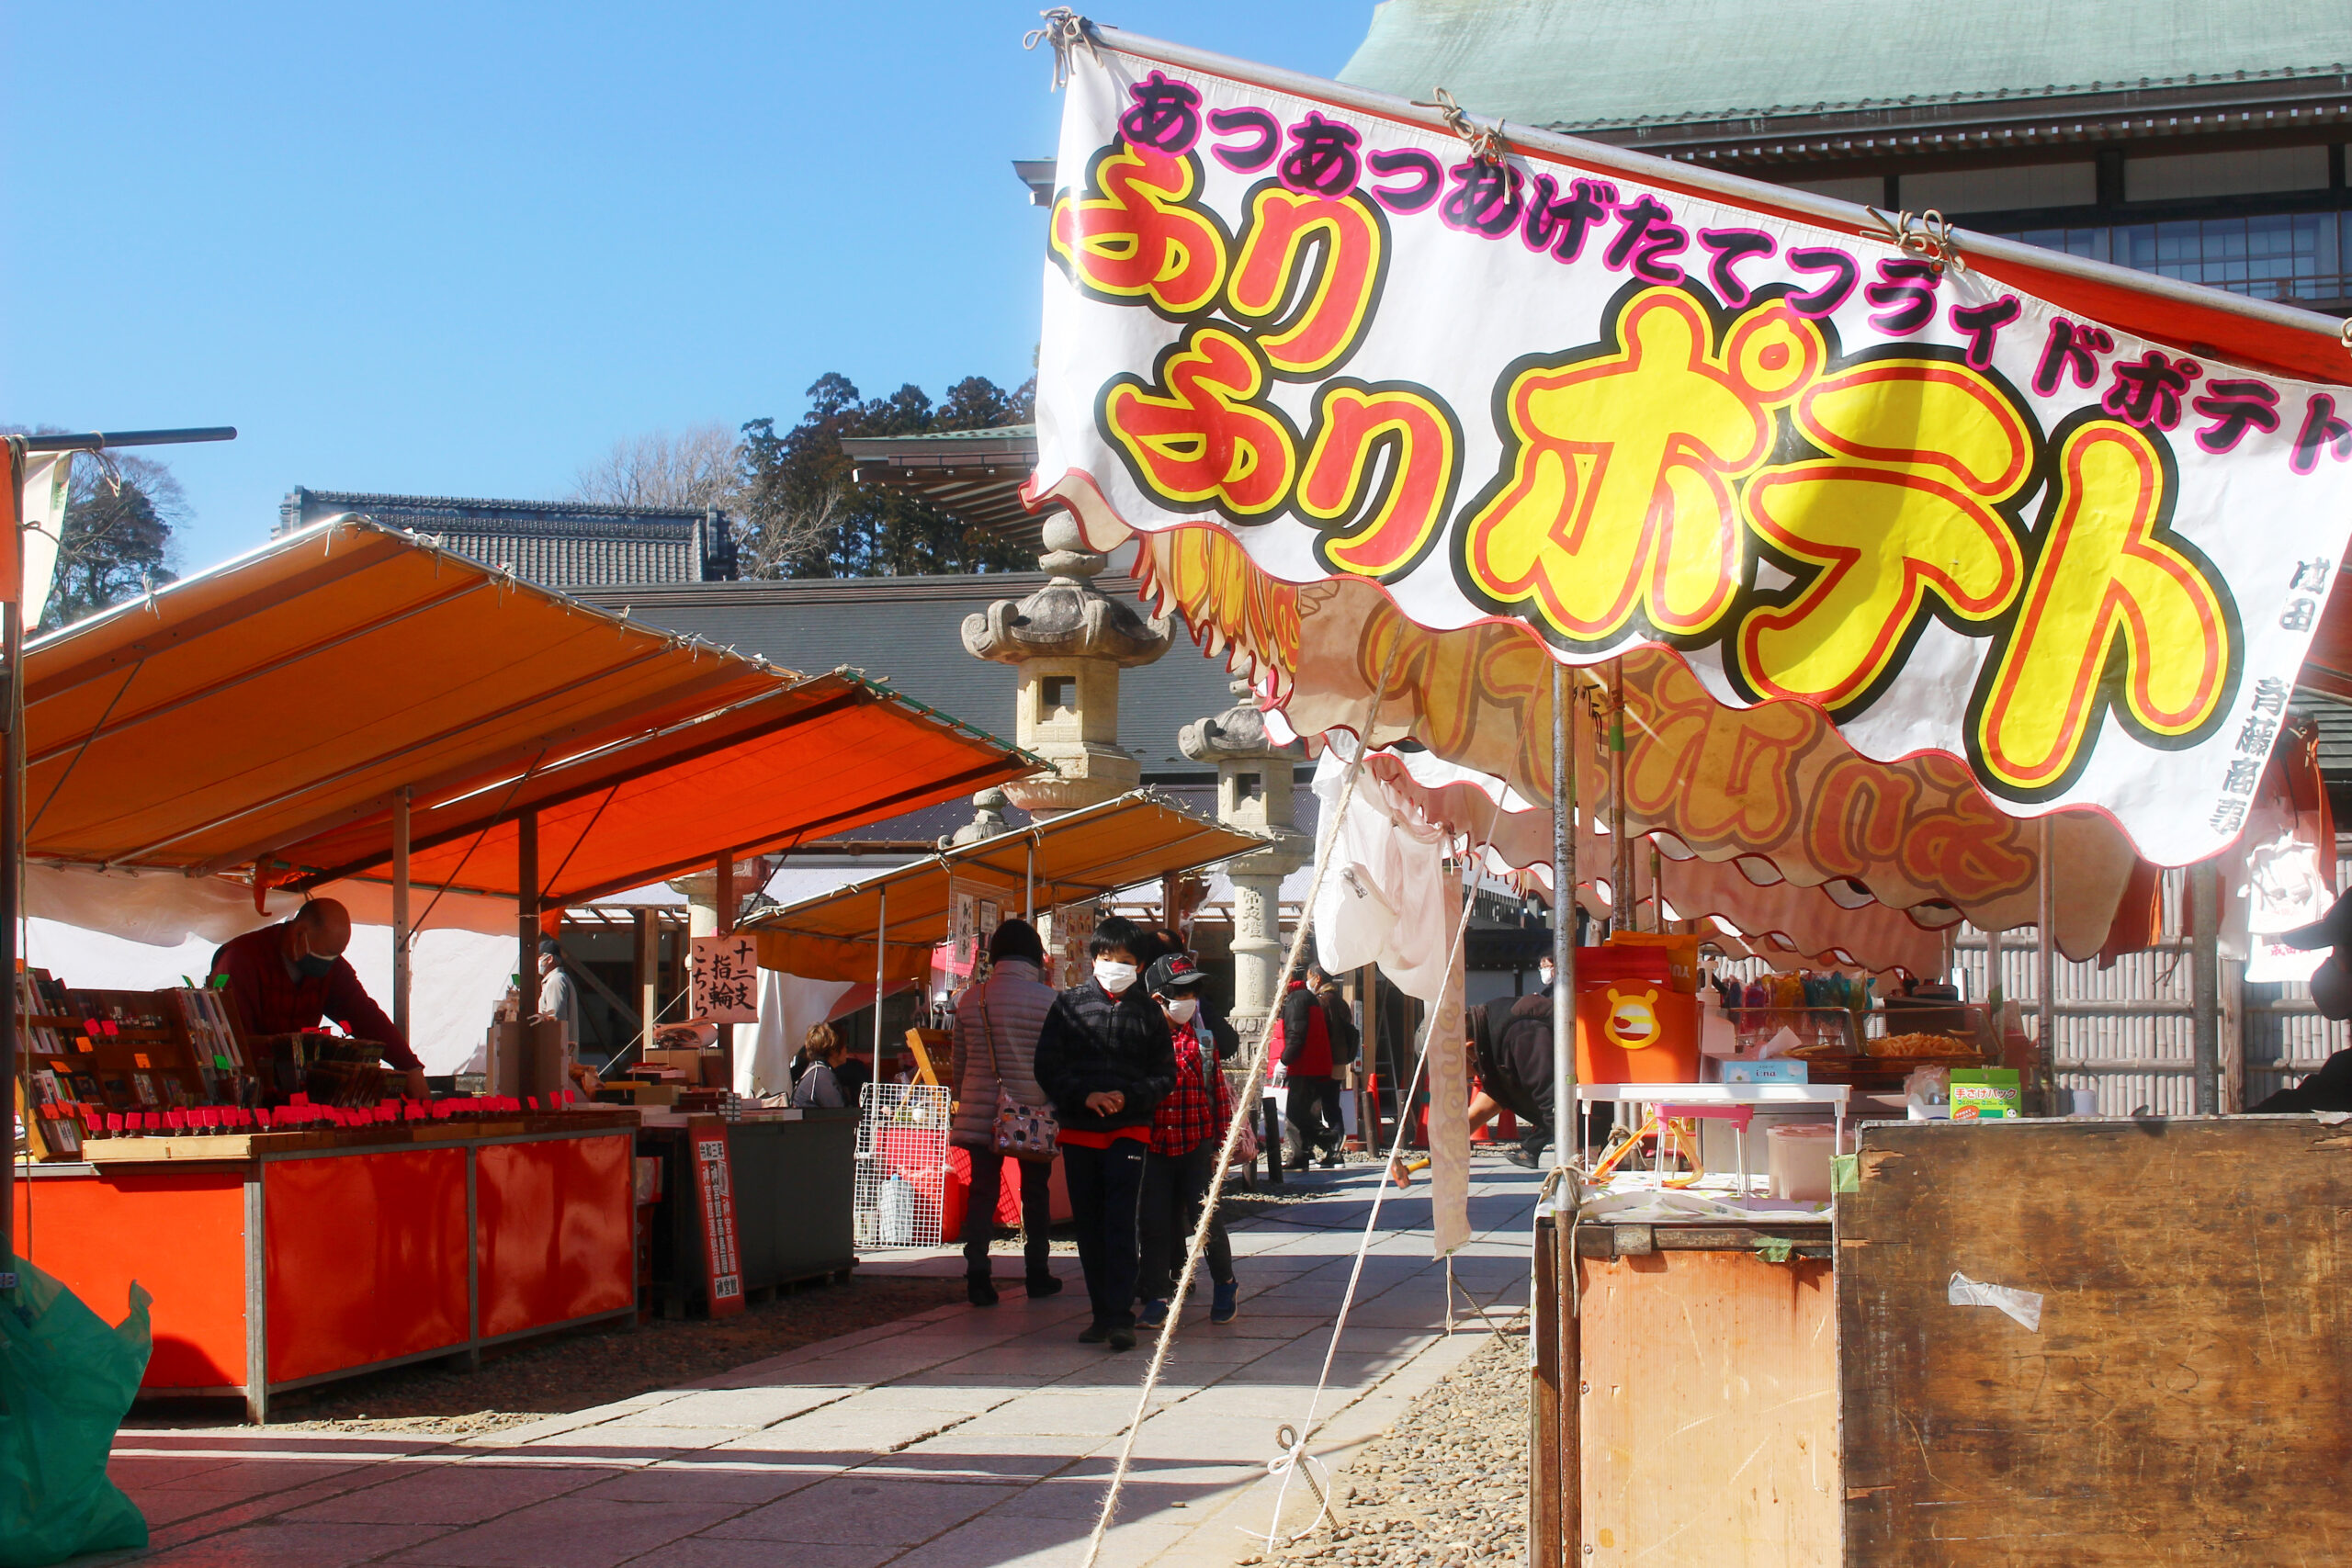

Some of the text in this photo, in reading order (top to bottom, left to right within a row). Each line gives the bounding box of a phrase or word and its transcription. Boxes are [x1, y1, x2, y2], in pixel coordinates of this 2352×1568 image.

[1450, 277, 2244, 805] ポテト
[693, 944, 708, 1017] こちら
[708, 953, 735, 1010] 指輪
[730, 940, 757, 1010] 十二支
[1954, 1088, 2018, 1100] 手さげパック
[716, 1278, 738, 1298] 神宮館
